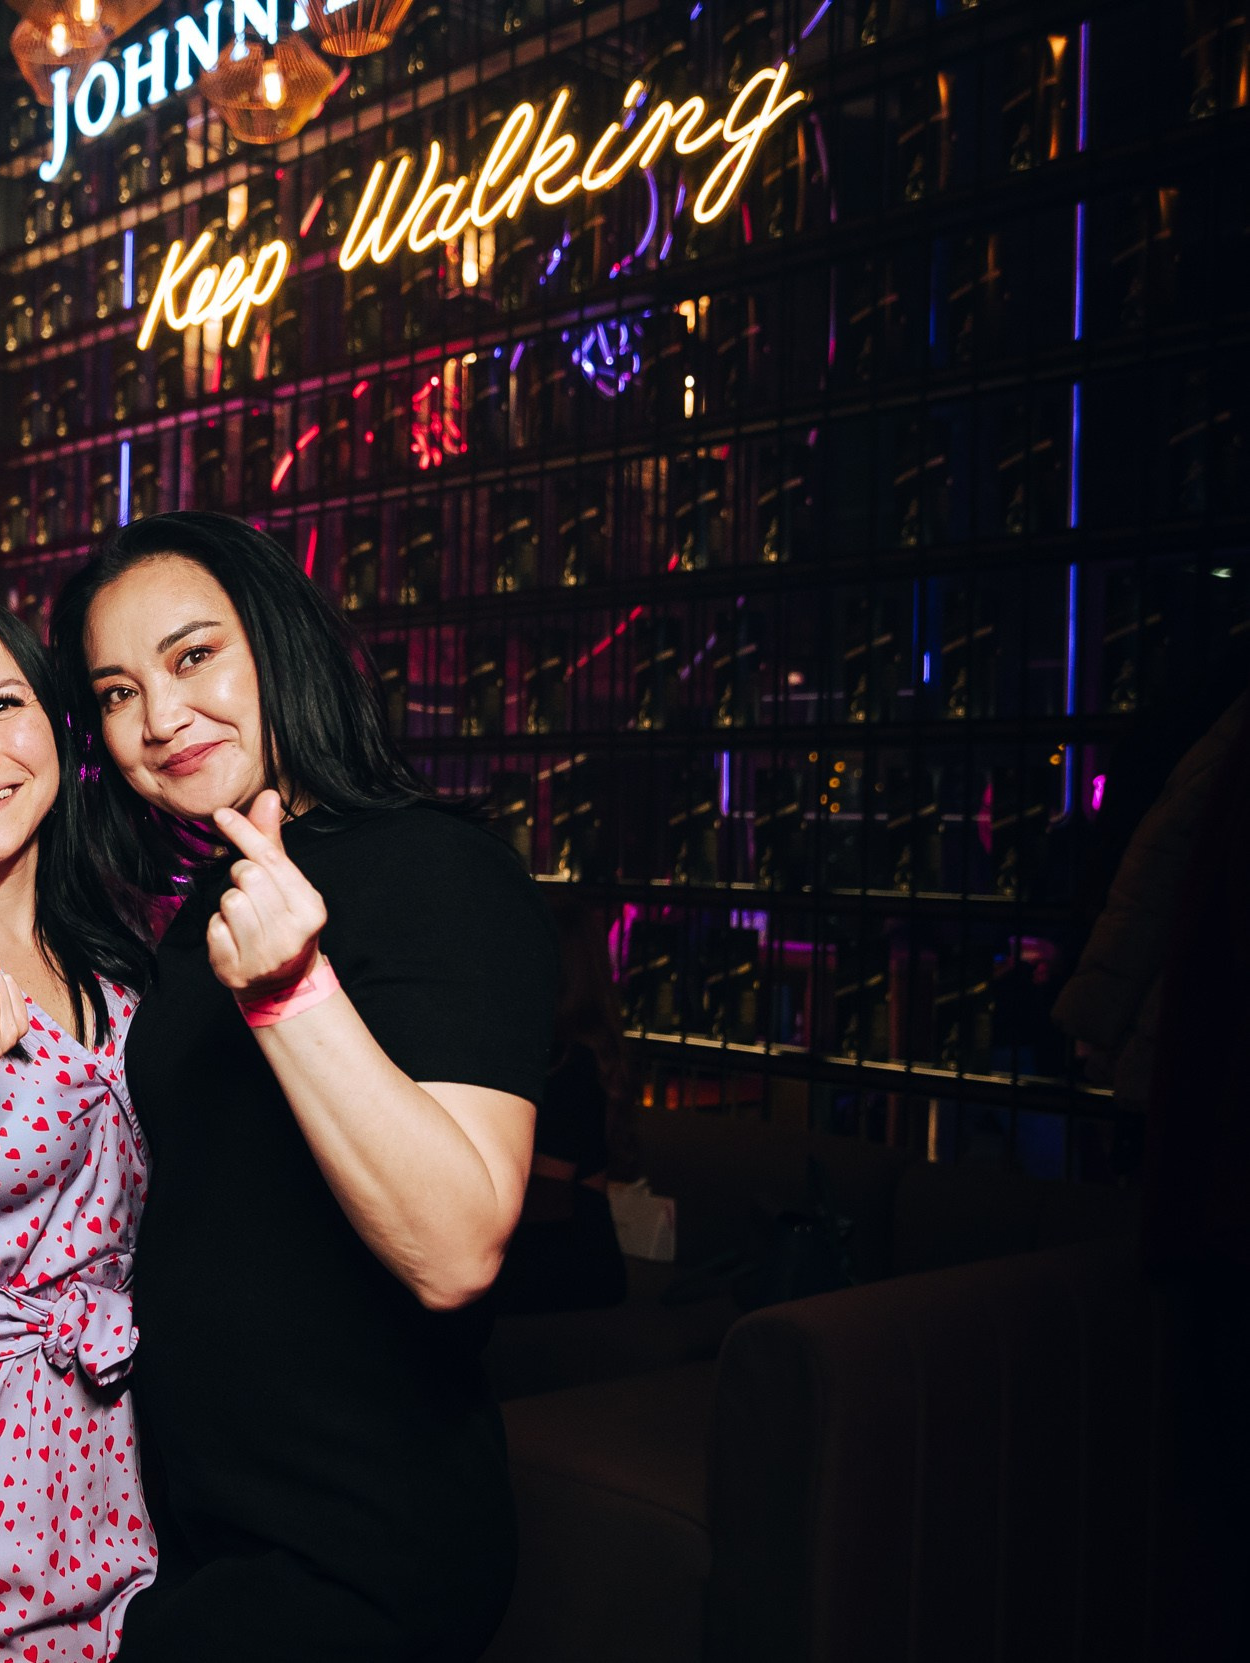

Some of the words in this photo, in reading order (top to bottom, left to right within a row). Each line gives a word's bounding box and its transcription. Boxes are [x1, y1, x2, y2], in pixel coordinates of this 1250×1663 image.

[39, 0, 358, 183] JOHNN
[137, 230, 290, 350] Keep
[338, 61, 805, 272] Walking
